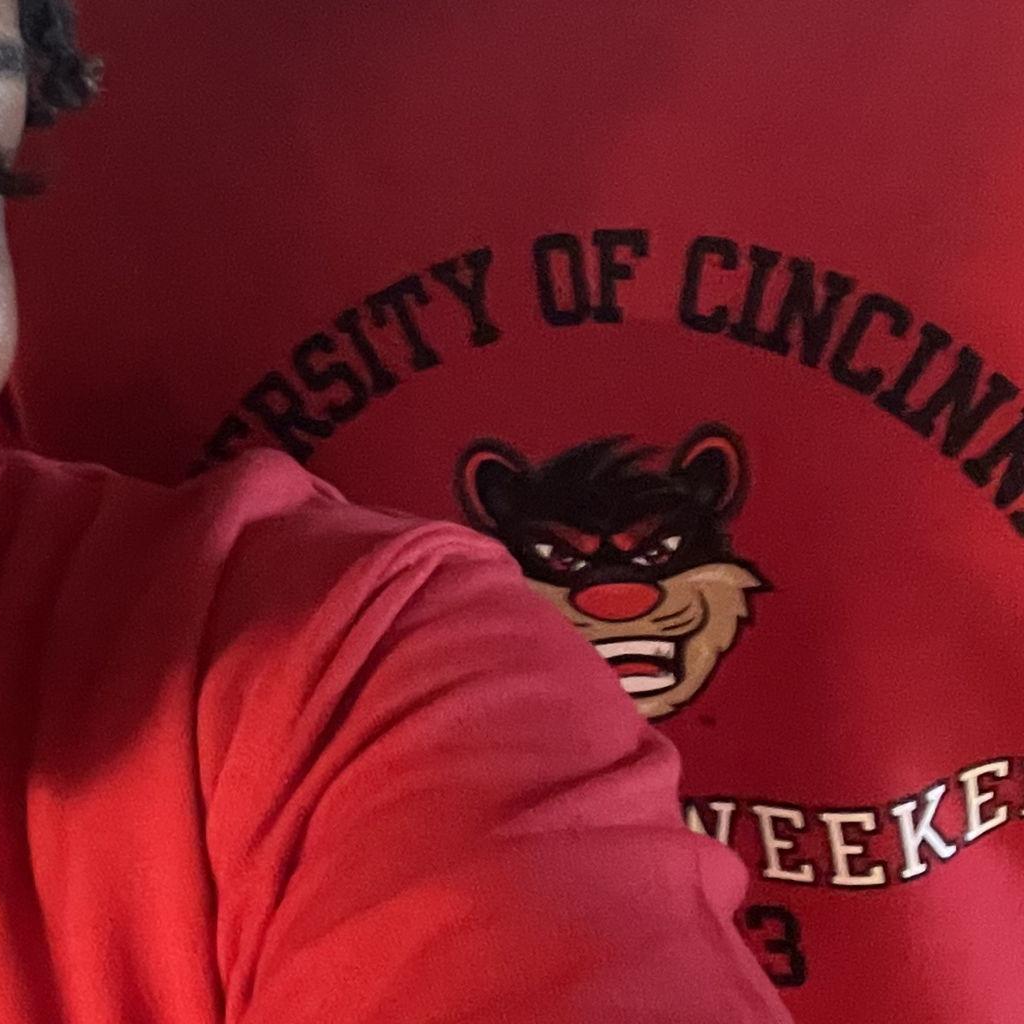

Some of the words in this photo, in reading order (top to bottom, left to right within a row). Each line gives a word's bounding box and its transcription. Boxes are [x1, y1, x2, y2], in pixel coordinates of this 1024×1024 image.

[531, 228, 650, 328] OF
[678, 233, 1024, 538] CINCINN
[685, 758, 1024, 887] EEKE
